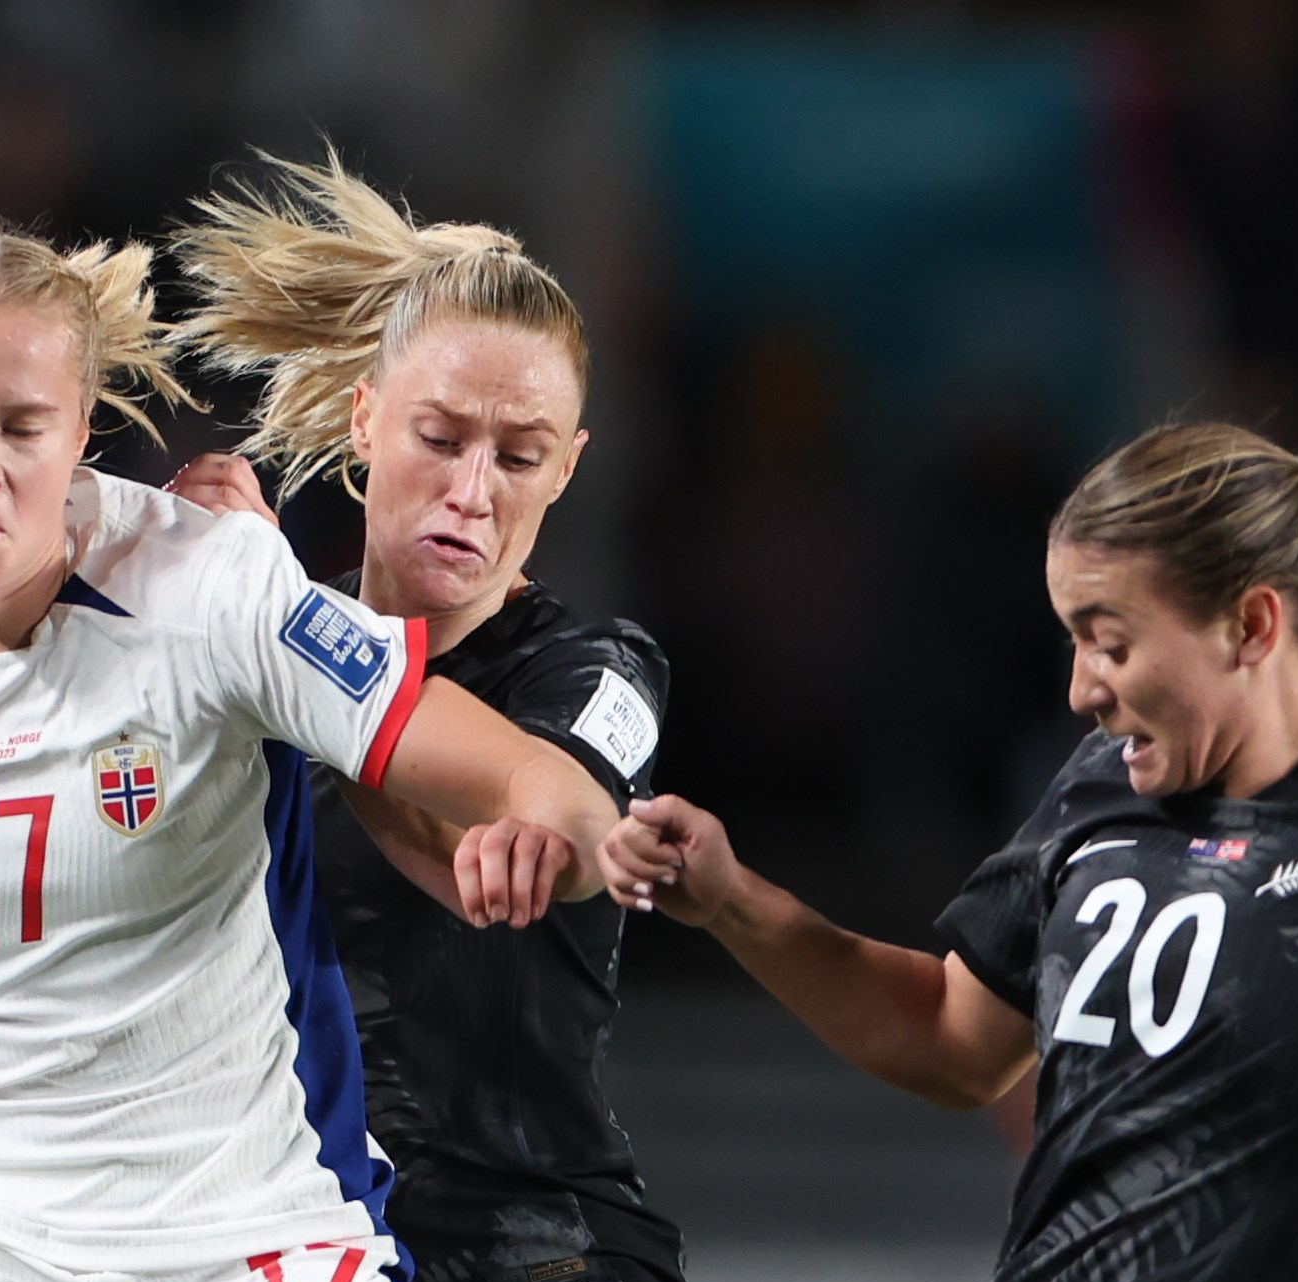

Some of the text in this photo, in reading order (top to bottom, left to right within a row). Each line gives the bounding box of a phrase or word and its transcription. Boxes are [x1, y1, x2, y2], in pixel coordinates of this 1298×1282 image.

[316, 610, 351, 652] UNITE
[613, 701, 645, 750] UNITES
[619, 691, 650, 736] FOOTBALL
[7, 731, 43, 746] NORGE
[1053, 877, 1227, 1058] 20
